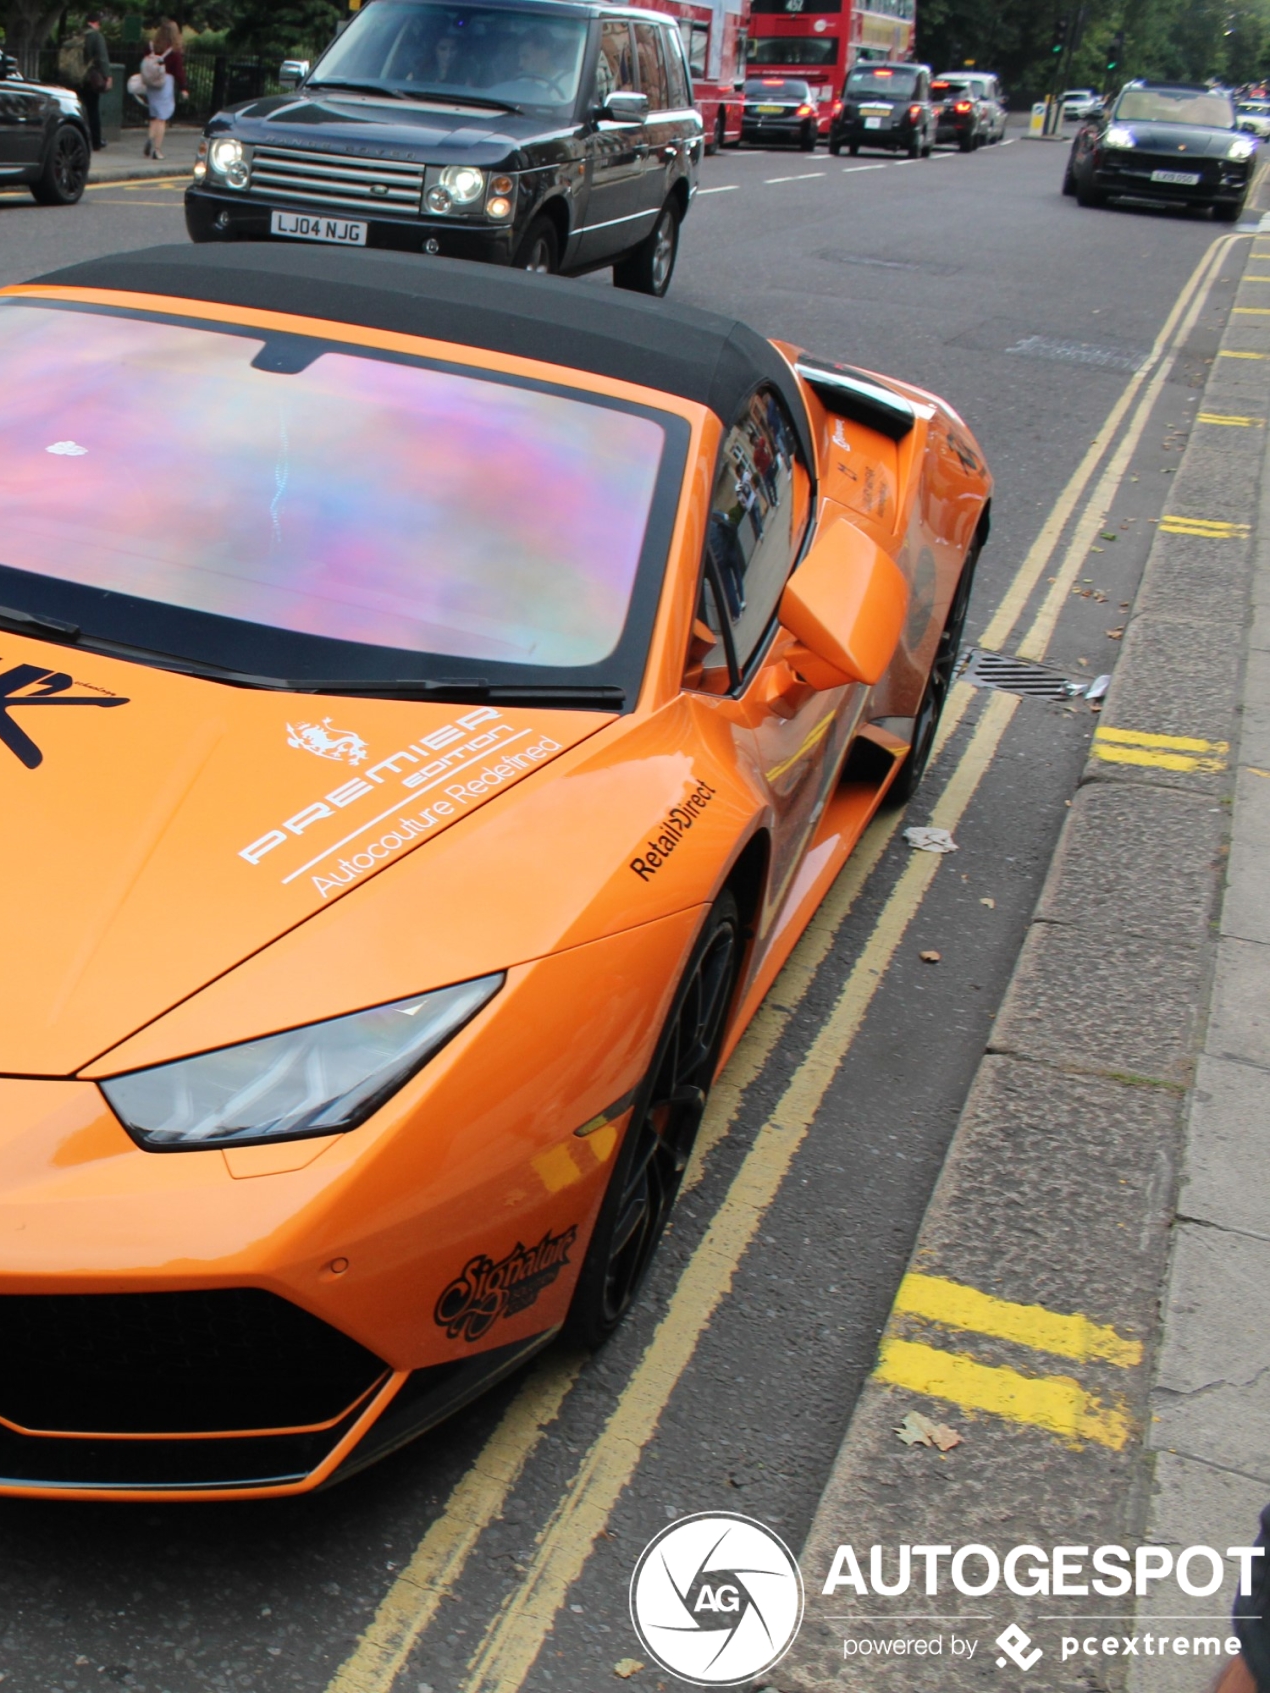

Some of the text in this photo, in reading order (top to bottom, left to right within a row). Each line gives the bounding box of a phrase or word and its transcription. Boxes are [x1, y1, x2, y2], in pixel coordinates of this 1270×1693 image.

[277, 214, 361, 242] LJ04 NJG
[238, 706, 503, 865] PREMIER
[402, 724, 515, 788] EDITION
[311, 735, 563, 898] Autocouture Redefined
